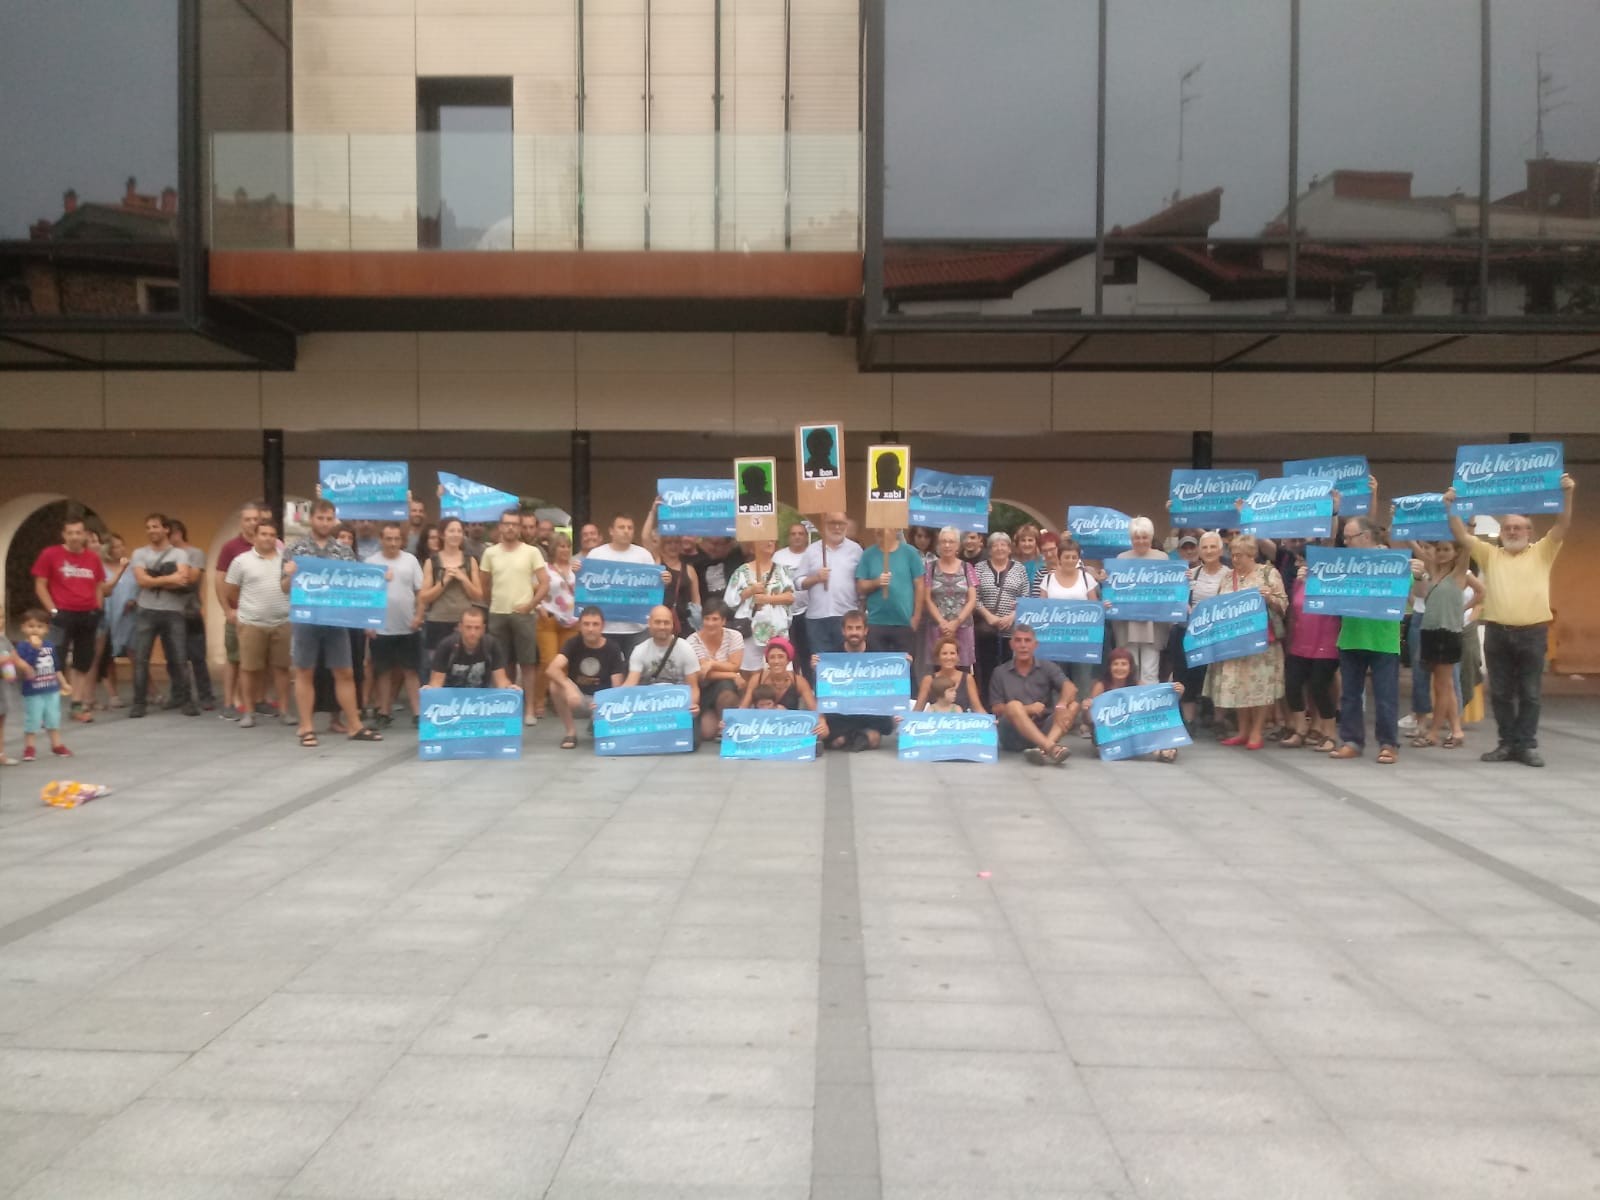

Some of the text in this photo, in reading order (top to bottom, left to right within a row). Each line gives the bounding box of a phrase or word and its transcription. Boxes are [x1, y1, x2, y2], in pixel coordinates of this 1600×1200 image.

[1457, 448, 1559, 483] 47ak herrian
[883, 490, 901, 498] xabi
[1246, 487, 1277, 510] 47ak
[1278, 482, 1332, 501] herrian
[749, 503, 772, 512] aitzol
[1310, 555, 1407, 581] 47ak herrian
[1049, 604, 1101, 624] herrian
